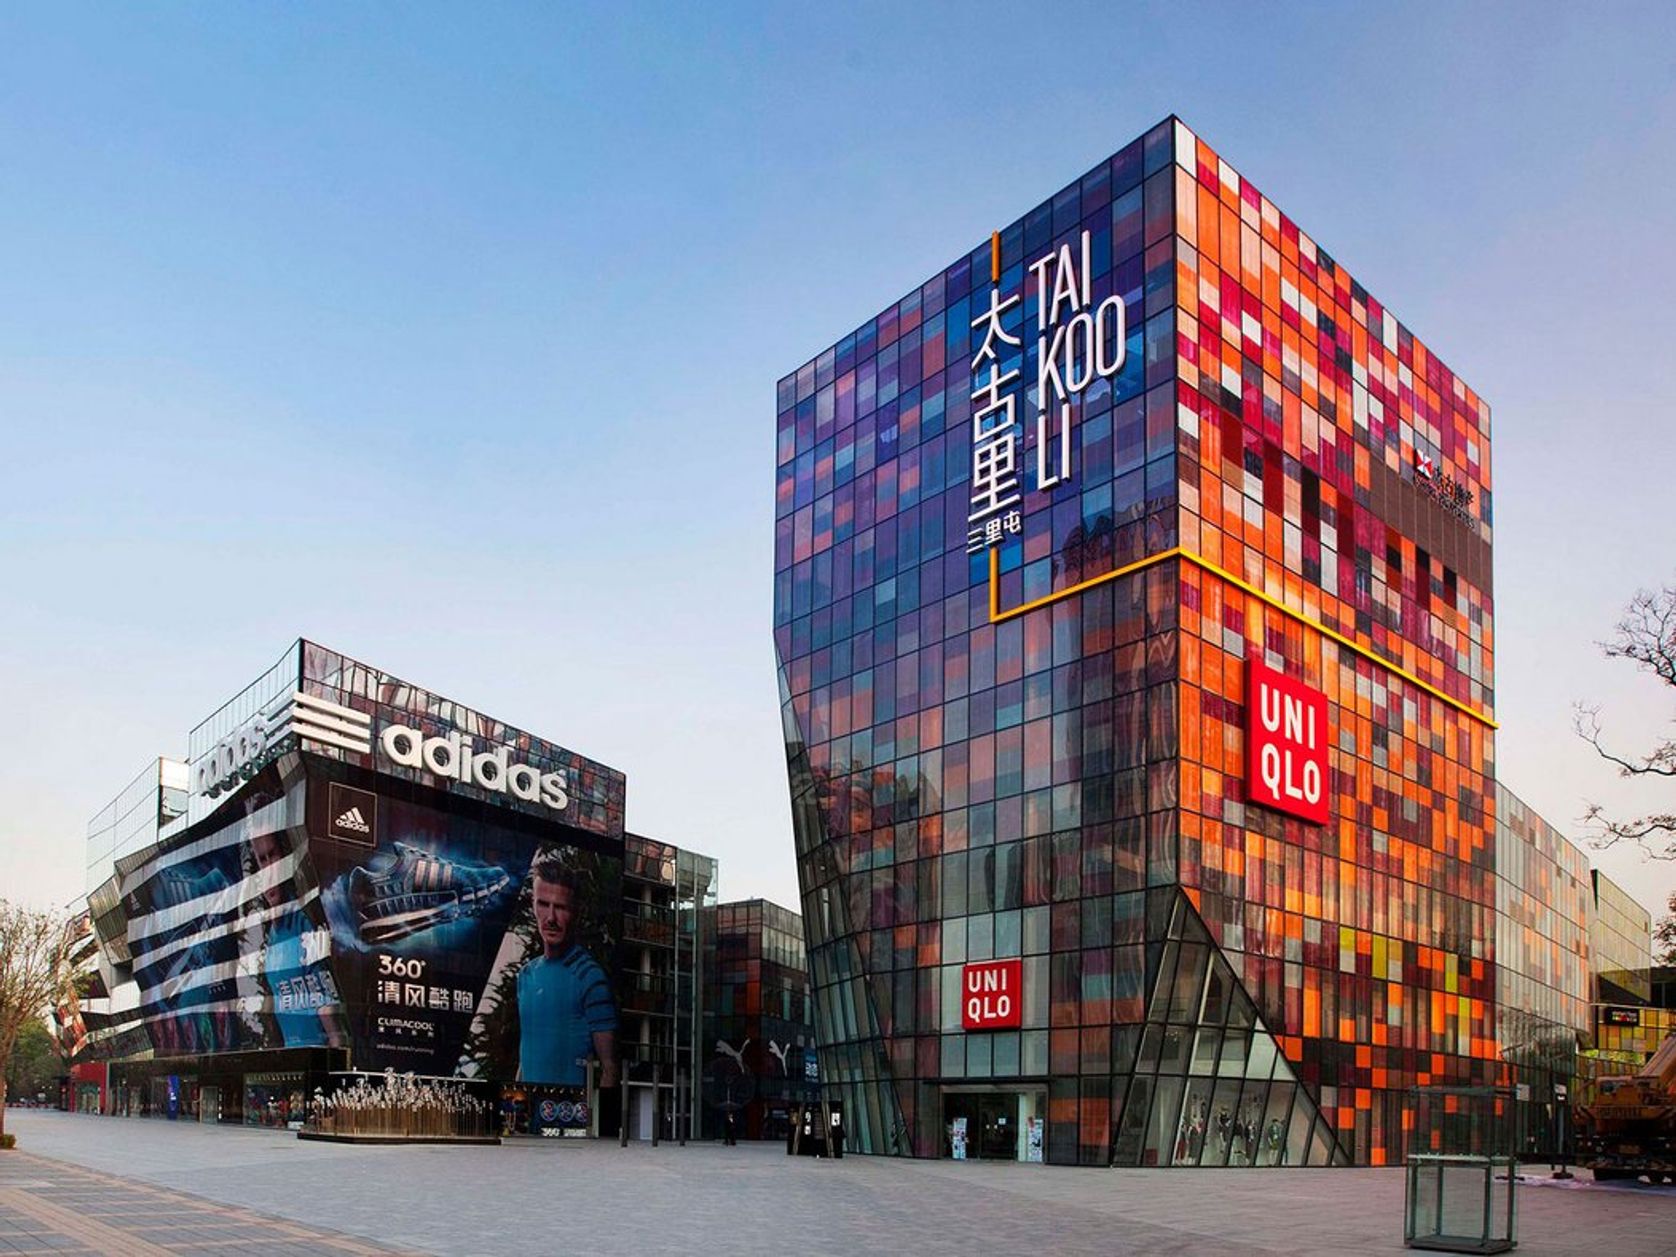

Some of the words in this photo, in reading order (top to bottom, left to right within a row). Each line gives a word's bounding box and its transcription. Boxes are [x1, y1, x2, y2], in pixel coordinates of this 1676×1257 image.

[1028, 229, 1091, 332] TAI
[1037, 294, 1126, 411] KOO
[967, 287, 1021, 522] 太古里
[1037, 402, 1071, 490] LI
[966, 510, 1022, 553] 三里屯
[1261, 682, 1315, 750] UNI
[380, 724, 568, 810] adidas
[1261, 743, 1321, 805] QLO
[335, 818, 369, 834] adidas
[377, 980, 474, 1014] 清风酷跑
[968, 968, 1007, 993] UNI
[968, 995, 1011, 1023] QLO
